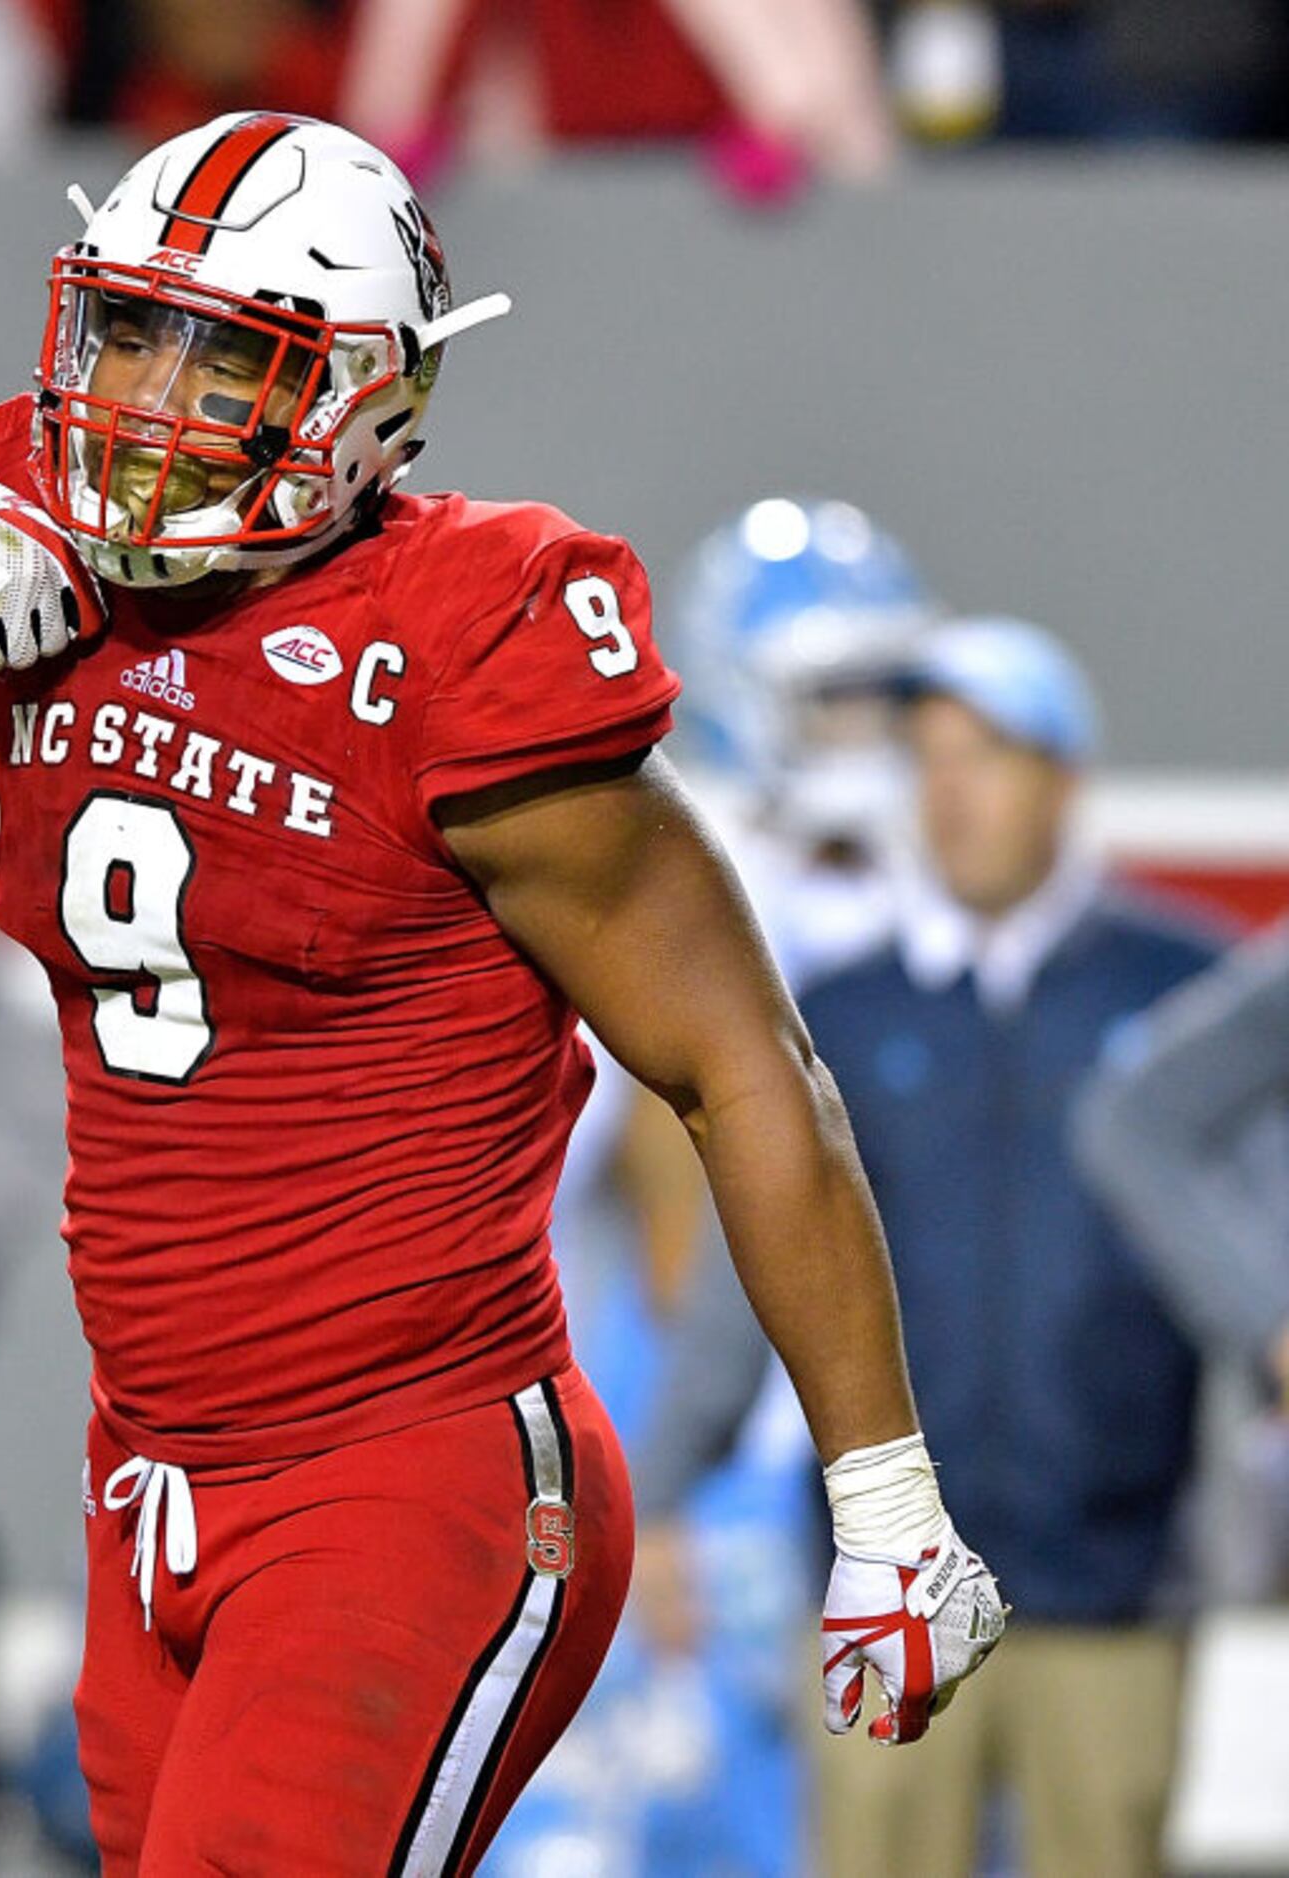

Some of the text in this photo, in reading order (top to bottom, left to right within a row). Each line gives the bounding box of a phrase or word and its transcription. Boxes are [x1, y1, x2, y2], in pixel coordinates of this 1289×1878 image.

[146, 249, 204, 272] ACC
[275, 638, 333, 668] ACC
[563, 574, 639, 679] 9
[120, 669, 195, 711] adidas
[350, 641, 407, 726] C
[10, 702, 335, 838] NC STATE
[57, 788, 217, 1087] 9
